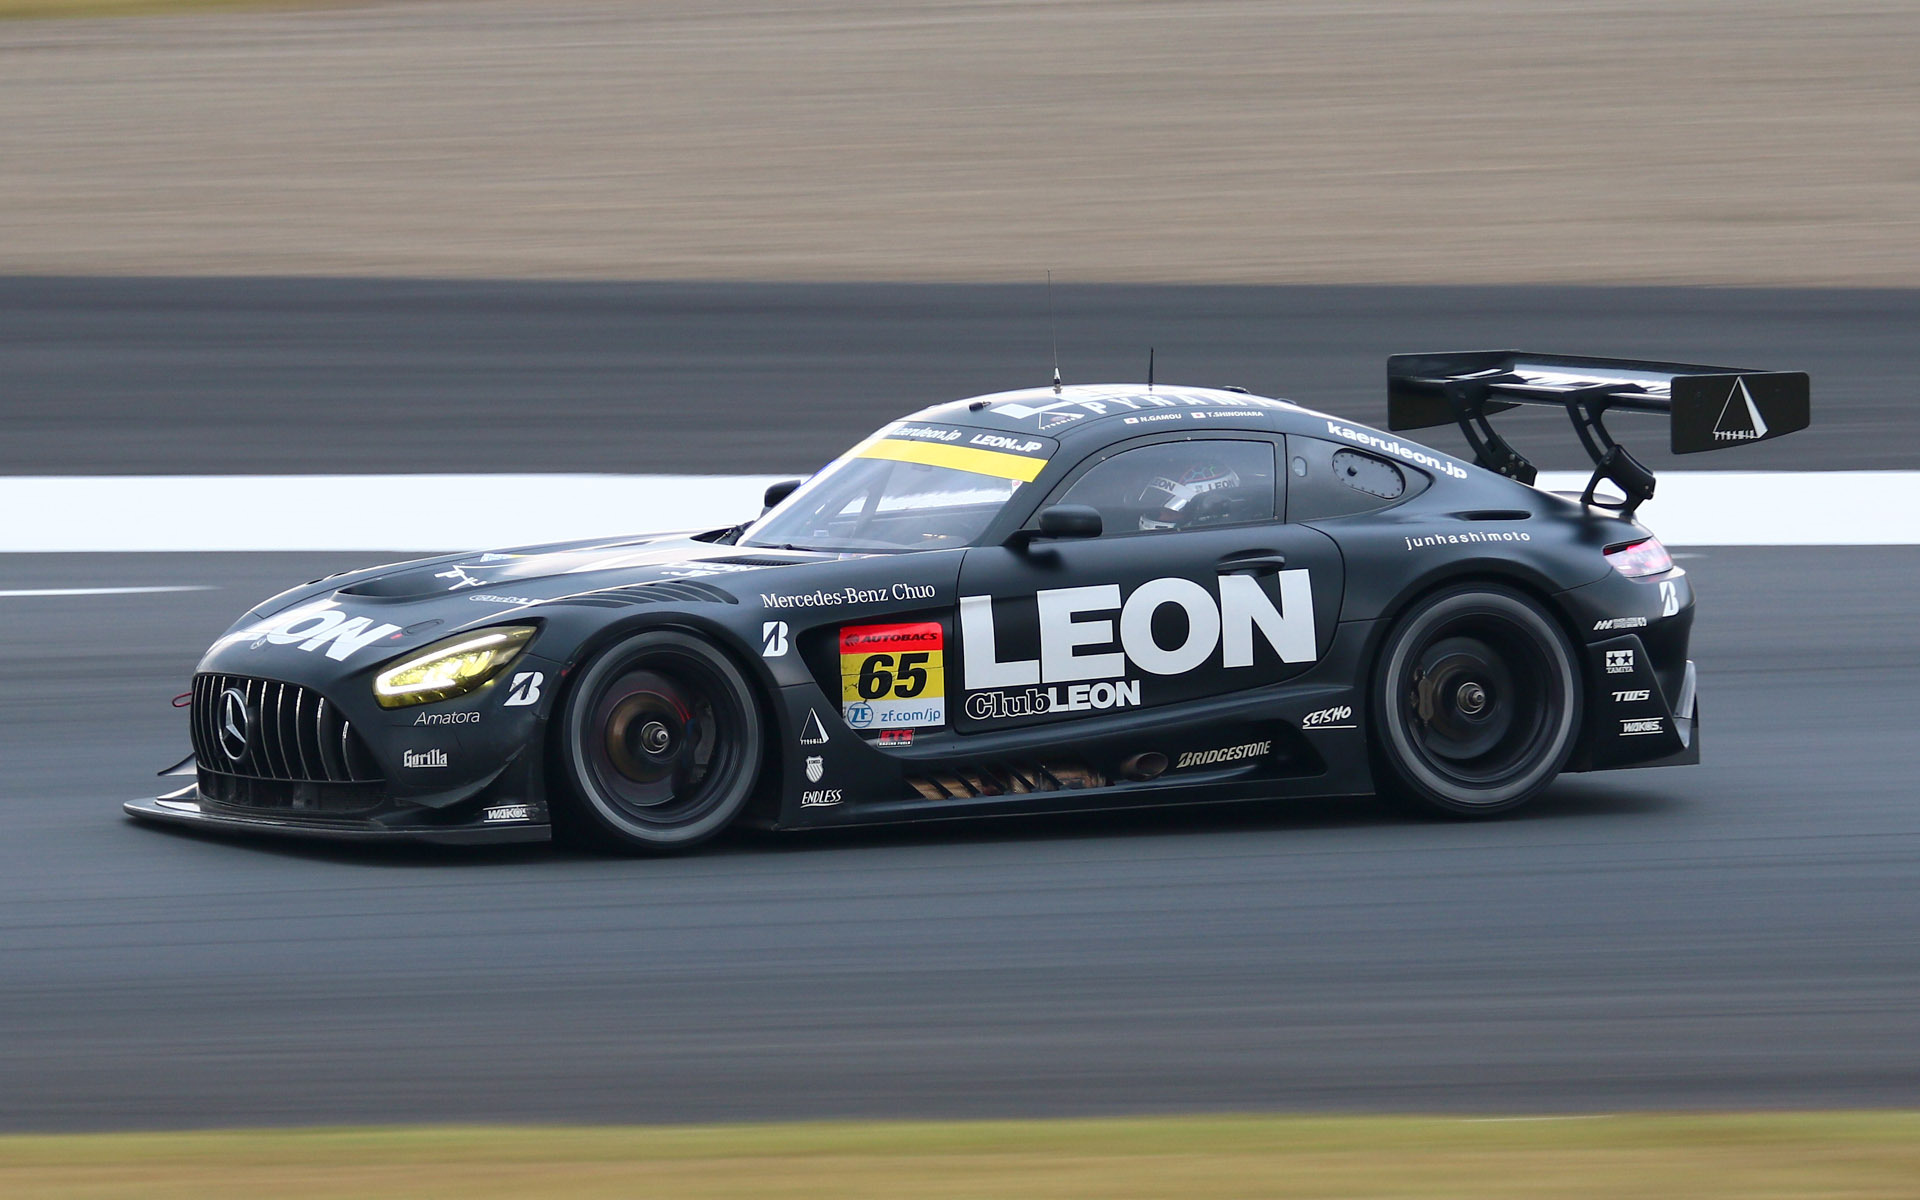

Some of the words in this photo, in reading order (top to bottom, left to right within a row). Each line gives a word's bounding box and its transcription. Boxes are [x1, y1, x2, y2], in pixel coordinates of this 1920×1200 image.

[969, 433, 1043, 453] LEON.JP
[1326, 420, 1468, 480] kaeruleon.jp
[1404, 531, 1531, 551] junhashimoto
[760, 586, 888, 608] Mercedes-Benz
[891, 583, 936, 600] Chuo
[862, 632, 938, 643] AUTOBACS
[959, 568, 1318, 690] LEON
[858, 652, 930, 700] 65
[1606, 666, 1634, 674] TAMIYA
[965, 679, 1141, 720] ClubLEON
[1612, 689, 1650, 702] TWS
[413, 711, 481, 726] Amatora
[850, 706, 872, 724] ZF
[881, 708, 941, 722] zf.com/jp
[1302, 705, 1352, 728] SEISHO
[403, 748, 448, 768] Gorilla
[1175, 740, 1272, 769] BRIDGESTONE
[801, 789, 843, 805] ENDLESS
